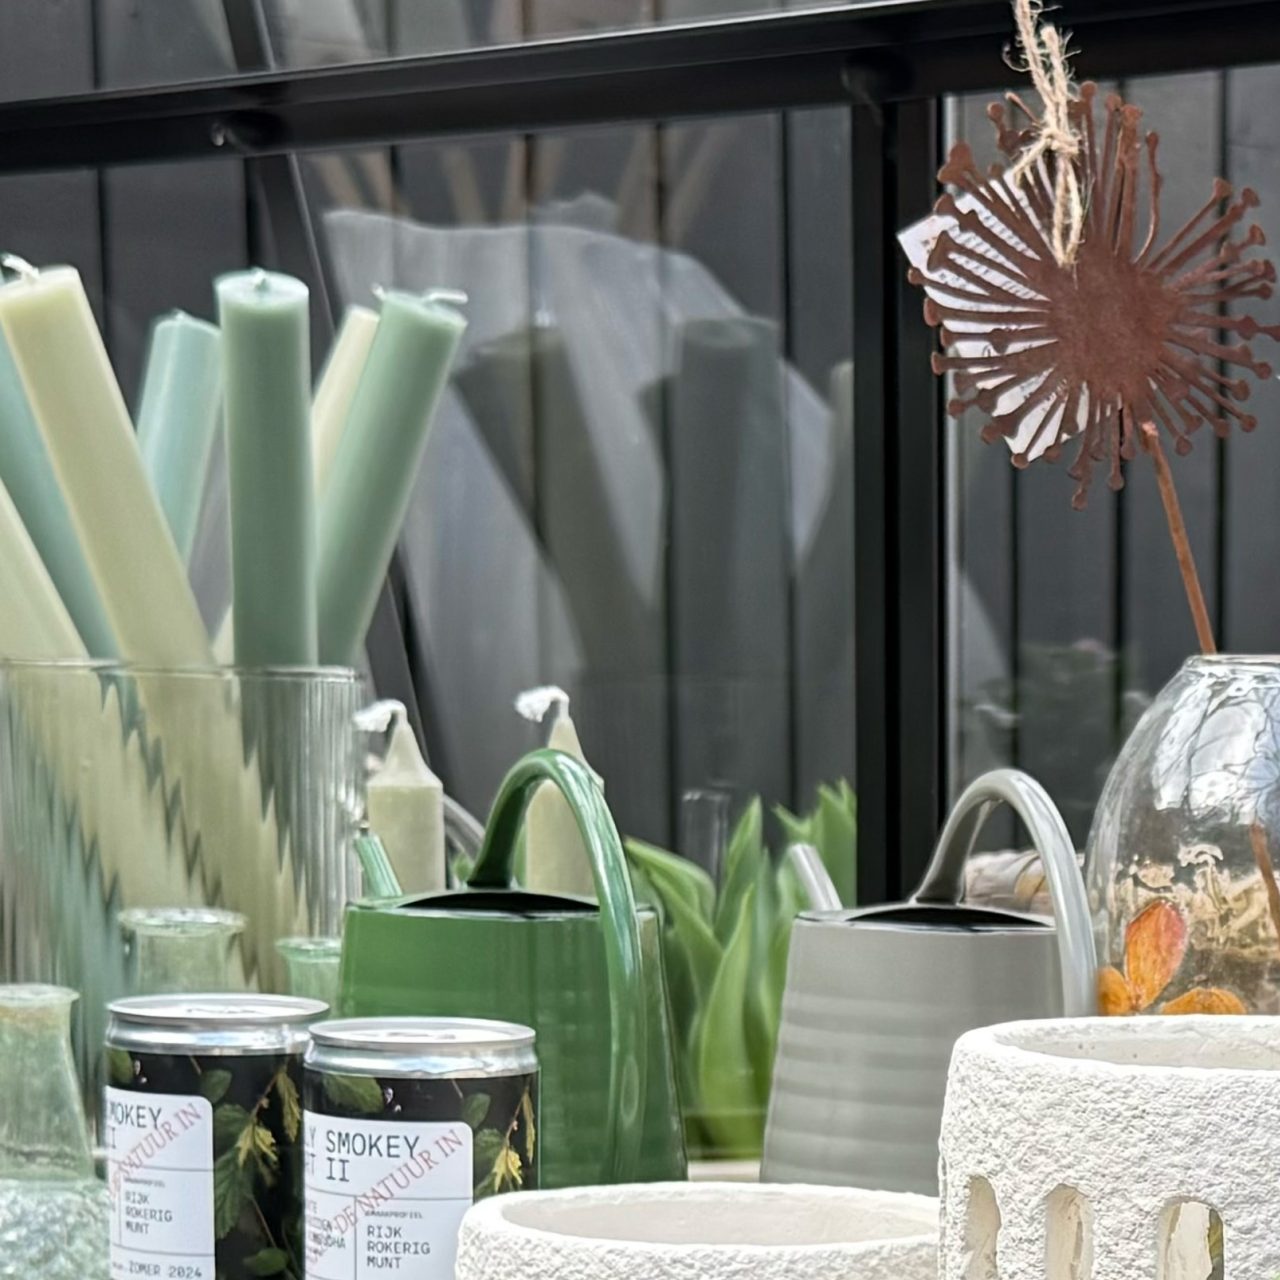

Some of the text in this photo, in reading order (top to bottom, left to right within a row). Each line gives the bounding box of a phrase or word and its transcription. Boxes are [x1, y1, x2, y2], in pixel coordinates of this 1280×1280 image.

[176, 1102, 202, 1132] IN
[326, 1130, 420, 1160] SMOKEY
[326, 1156, 350, 1182] II
[356, 1149, 439, 1213] NATUUR
[434, 1128, 464, 1158] IN
[125, 1206, 173, 1222] ROKERIG
[366, 1225, 402, 1239] RIJK
[366, 1241, 431, 1255] ROKERIG
[366, 1256, 402, 1270] MUNT
